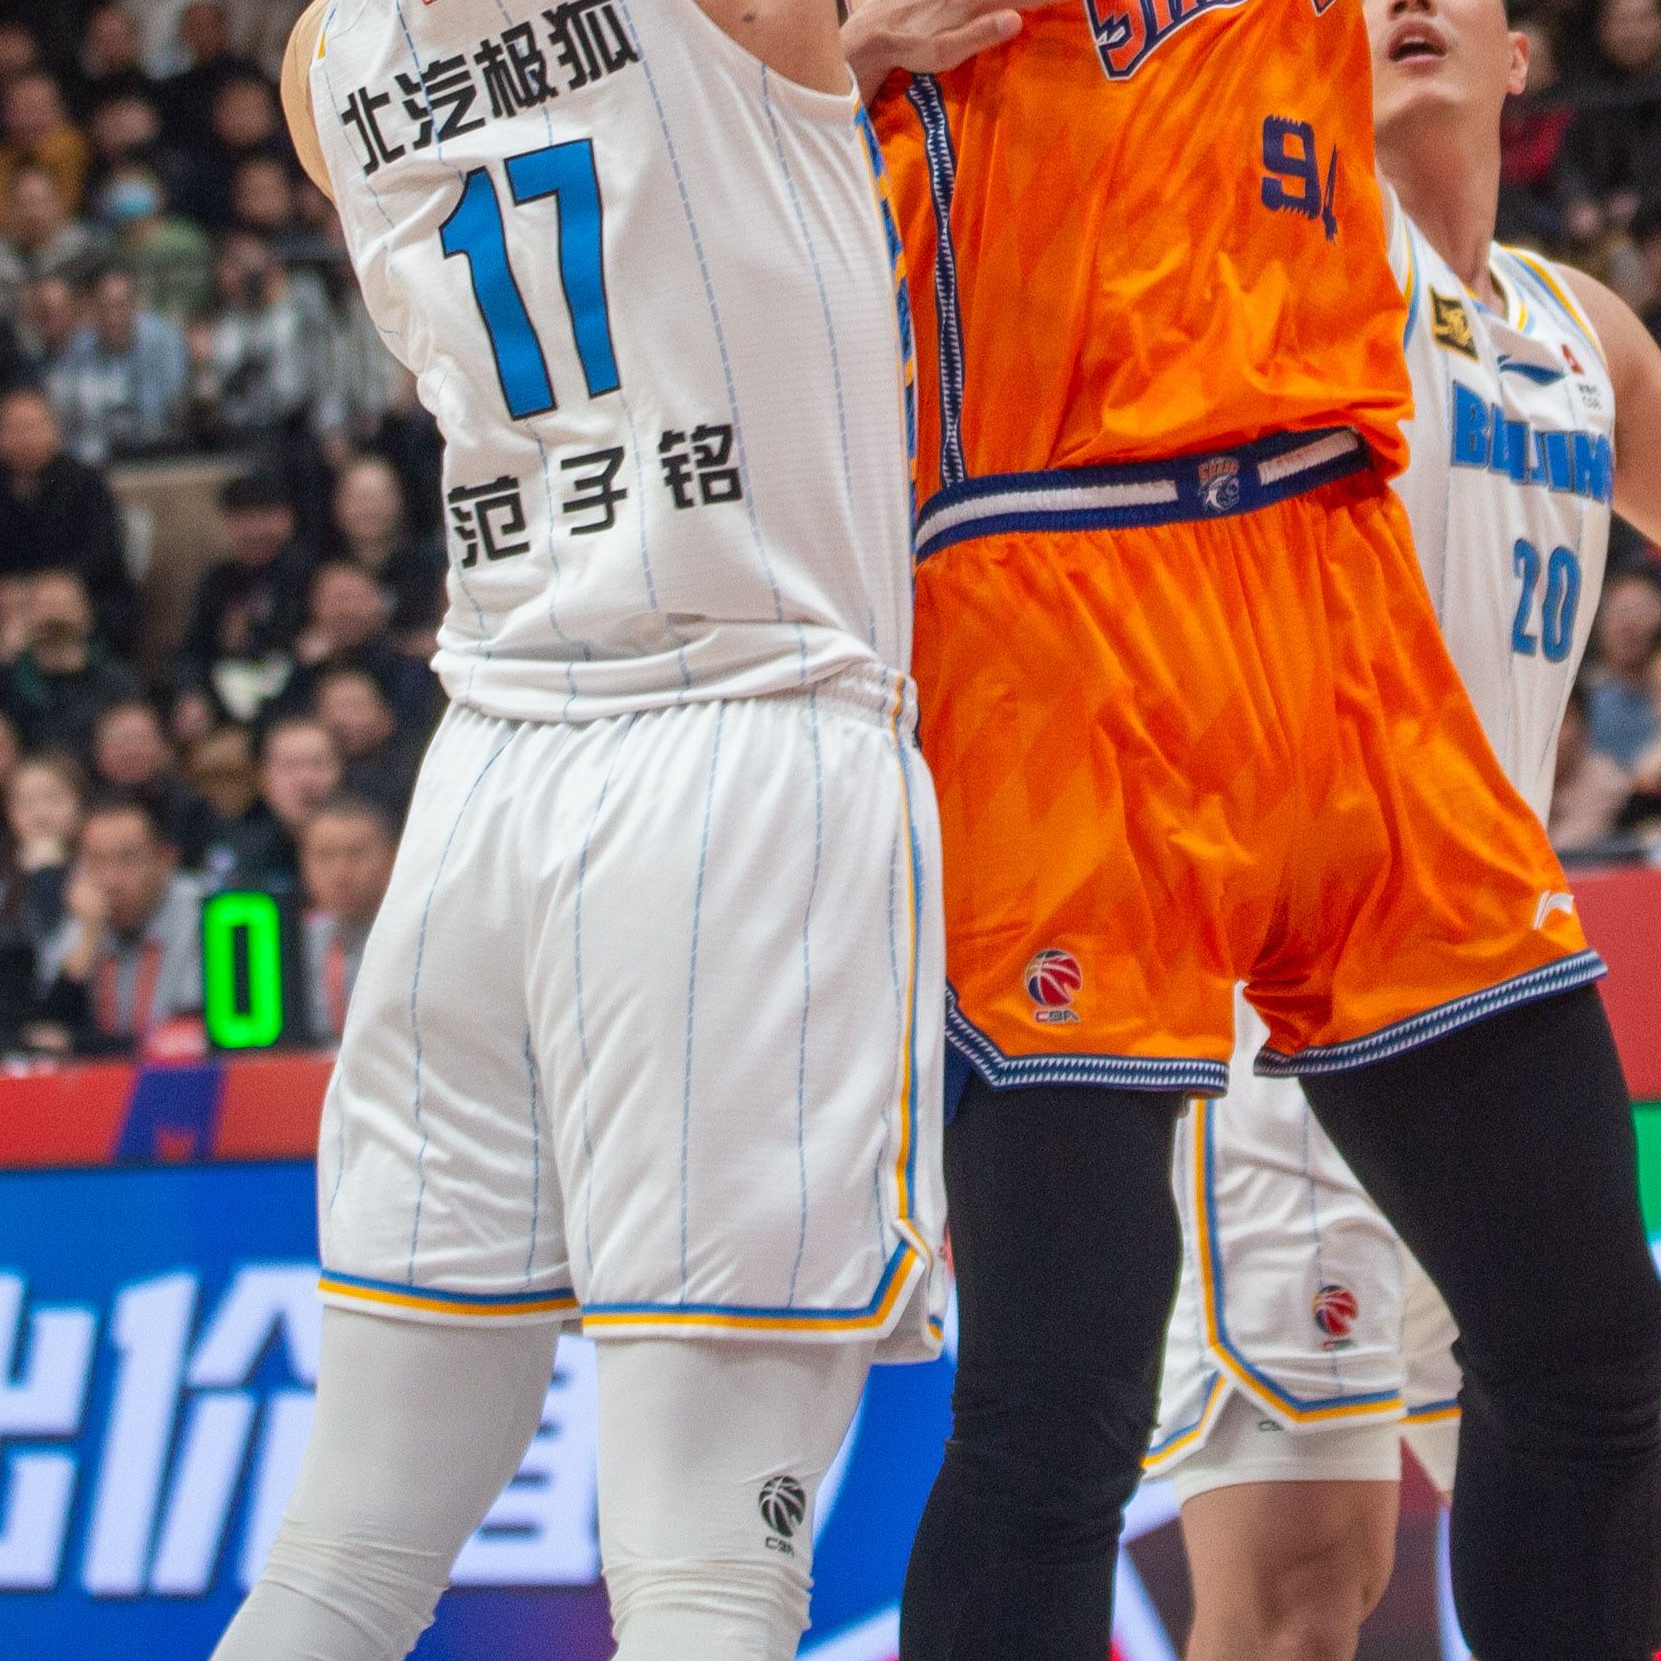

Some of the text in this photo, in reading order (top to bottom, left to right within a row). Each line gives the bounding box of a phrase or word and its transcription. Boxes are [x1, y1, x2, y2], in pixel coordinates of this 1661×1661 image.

[439, 138, 622, 421] 17
[447, 423, 743, 569] 范子铭
[1512, 538, 1582, 663] 20
[203, 890, 283, 1049] 0
[1035, 1009, 1079, 1022] CBA
